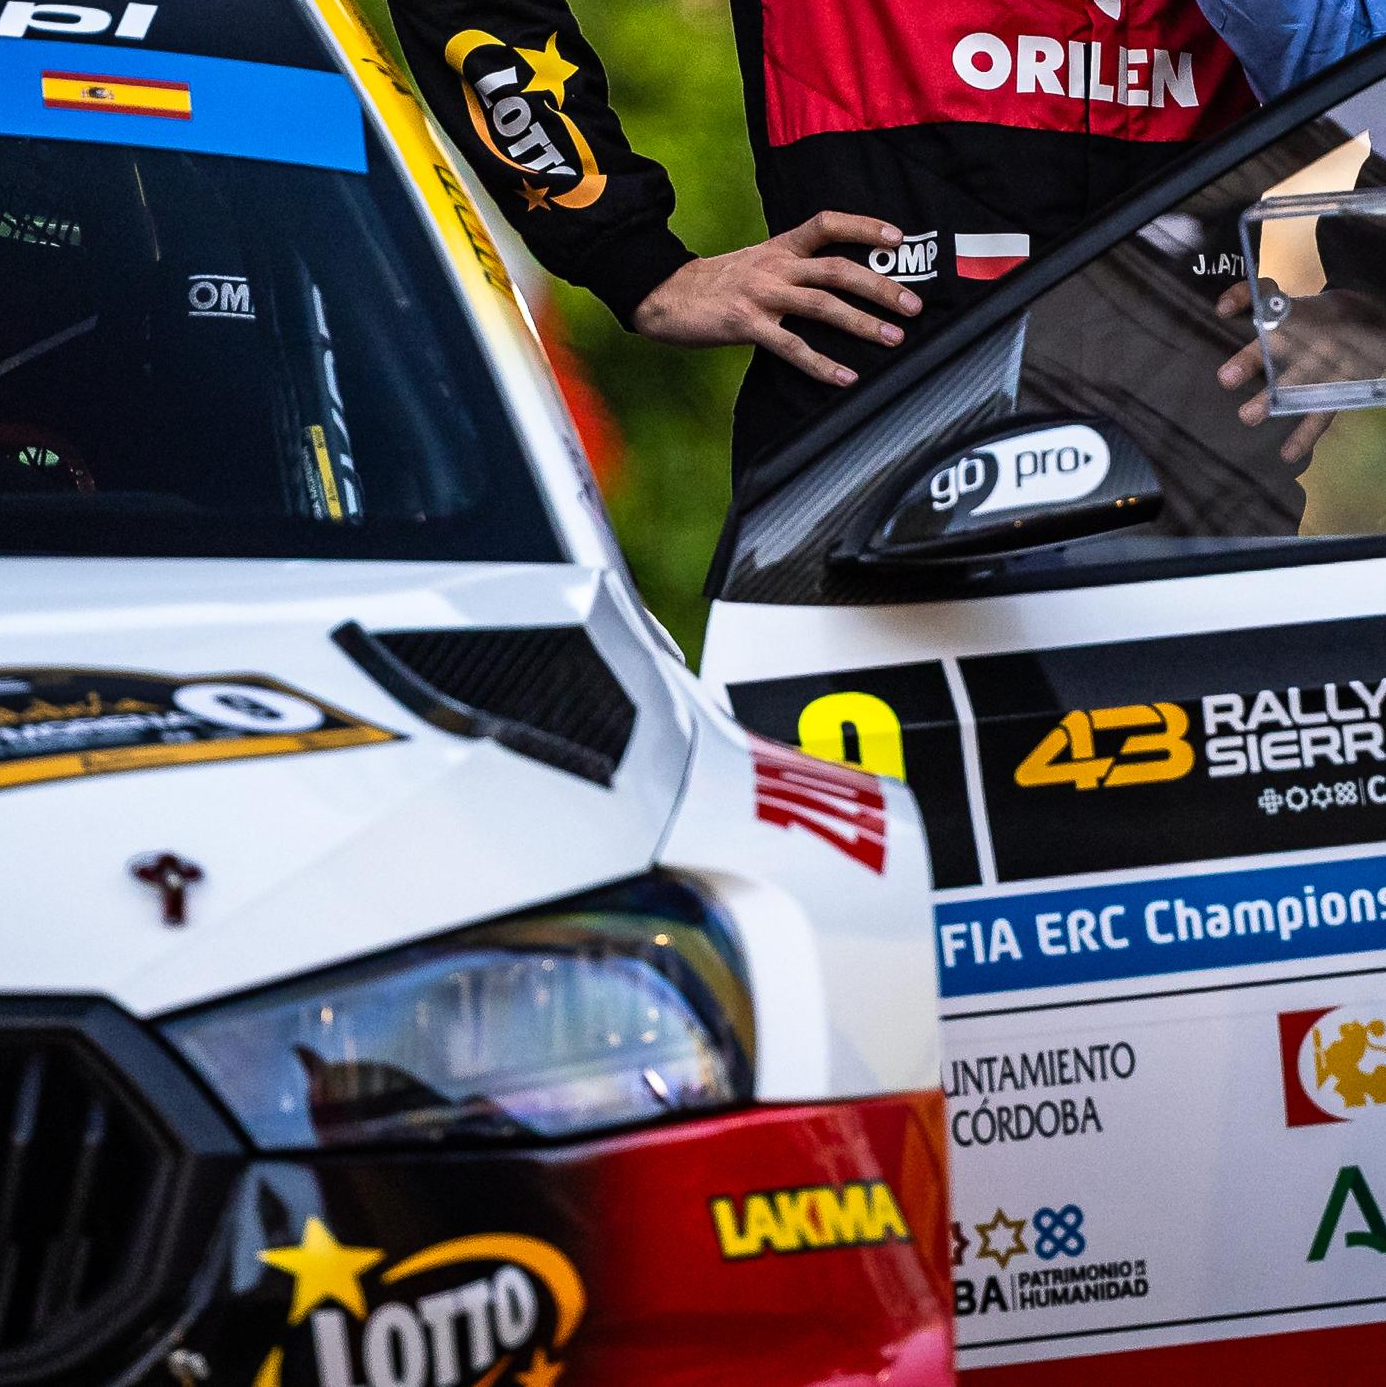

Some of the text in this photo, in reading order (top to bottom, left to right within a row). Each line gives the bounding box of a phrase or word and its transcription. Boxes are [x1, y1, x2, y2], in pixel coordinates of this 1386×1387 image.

[868, 240, 938, 274] OMP
[1014, 702, 1196, 791] 43
[940, 917, 1023, 968] FIA
[1036, 905, 1130, 956] ERC
[941, 1041, 1137, 1099] UNTAMIENTO
[951, 1096, 1104, 1149] CÓRDOBA
[714, 1184, 910, 1259] LAKMA
[1017, 1261, 1132, 1289] PATRIMONIO
[1018, 1277, 1149, 1311] HUMANIDAD
[312, 1264, 539, 1387] LOTTO
